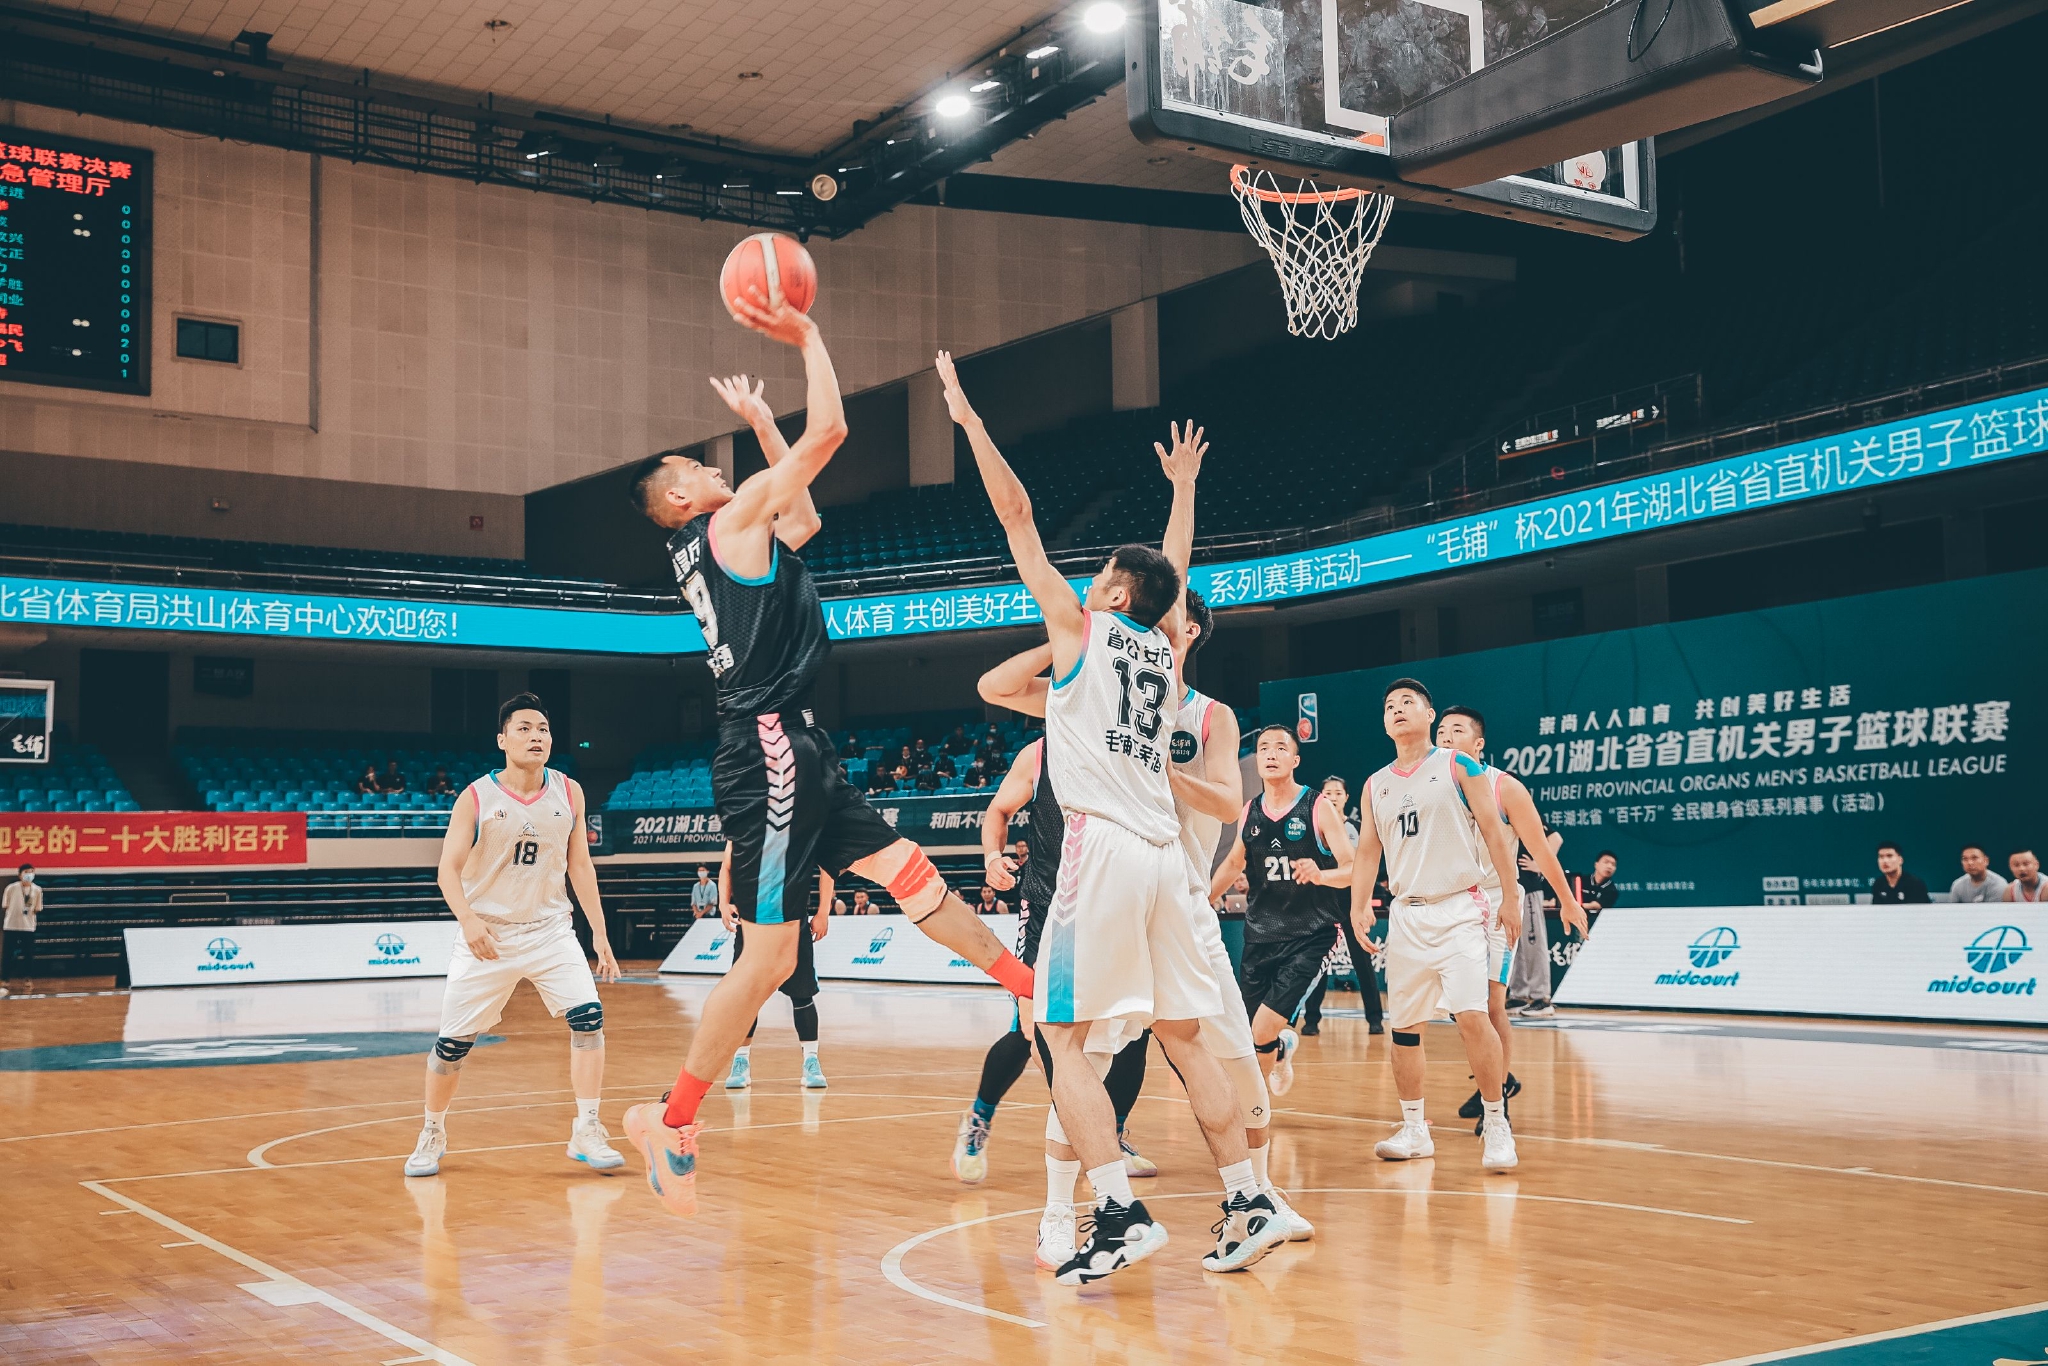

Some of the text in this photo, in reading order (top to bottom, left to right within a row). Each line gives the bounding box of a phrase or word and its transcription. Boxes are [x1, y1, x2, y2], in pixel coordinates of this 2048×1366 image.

[122, 205, 130, 214] 0
[122, 219, 130, 229] 0
[121, 234, 130, 244] 0
[121, 249, 130, 259] 0
[121, 264, 130, 274] 0
[121, 279, 130, 289] 0
[121, 294, 130, 304] 0
[121, 309, 130, 319] 0
[121, 324, 130, 333] 0
[121, 338, 130, 348] 2
[121, 353, 130, 363] 0
[121, 369, 128, 378] 1
[904, 592, 1044, 630] 共创美好生
[1113, 656, 1171, 743] 13
[1695, 684, 1851, 720] 共创美好生活
[1502, 700, 2011, 777] 2021湖北省省直机关男子篮球联赛
[1540, 784, 1582, 802] HUBEI
[1585, 777, 1675, 799] PROVINCIAL
[1680, 773, 1750, 792] ORGANS
[1755, 768, 1808, 788] MEN'S
[1812, 760, 1921, 784] BASKETBALL
[1927, 754, 2008, 776] LEAGUE
[633, 814, 722, 834] 2021湖北省
[1397, 810, 1420, 839] 10
[633, 833, 727, 844] 2021 HUBEI PROVINCI
[513, 840, 539, 866] 18
[1264, 856, 1291, 881] 21
[368, 955, 421, 965] midcourt
[197, 960, 256, 971] midcourt
[1654, 970, 1741, 987] midcourt
[1927, 976, 2038, 996] midcourt
